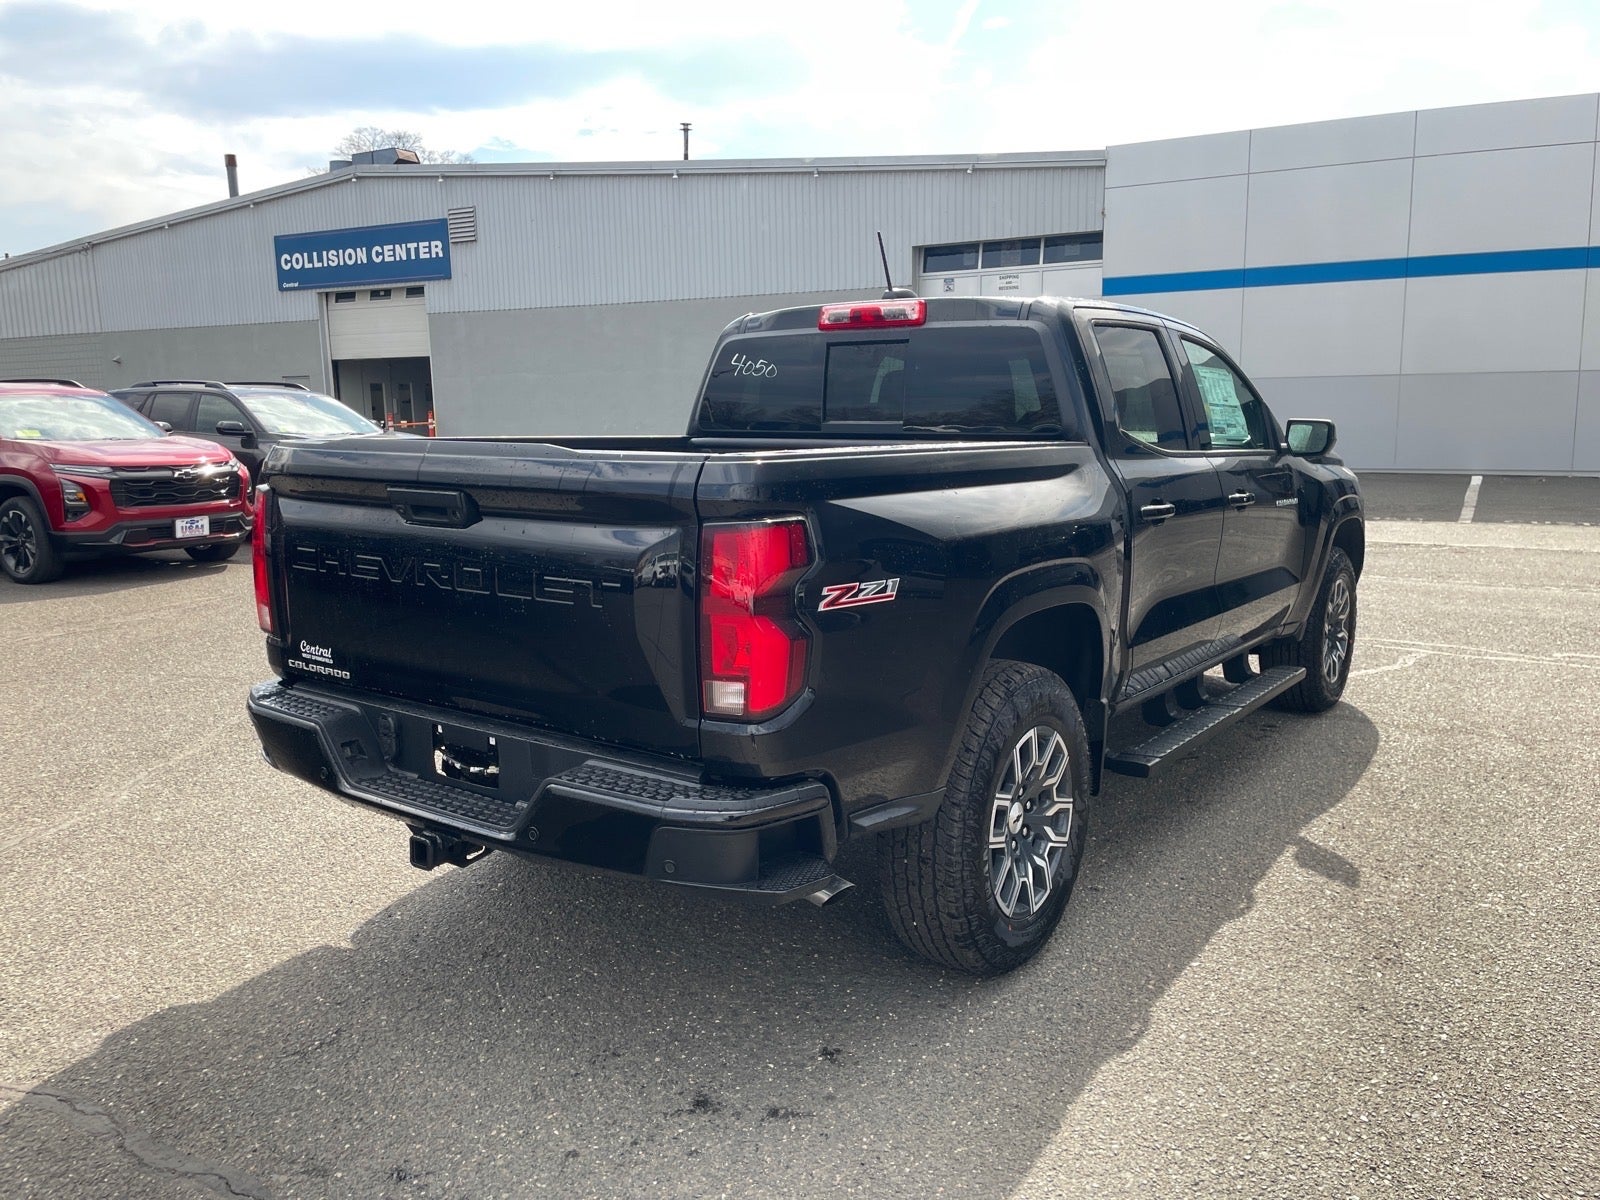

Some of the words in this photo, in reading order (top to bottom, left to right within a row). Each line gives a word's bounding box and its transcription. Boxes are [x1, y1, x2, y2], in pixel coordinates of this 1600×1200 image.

[280, 247, 367, 271] COLLISION
[371, 240, 443, 263] CENTER
[282, 281, 299, 289] Central
[731, 353, 777, 378] 4050
[292, 546, 622, 608] CHEVROLET
[818, 578, 900, 612] Z71
[300, 640, 332, 658] Central
[288, 659, 350, 679] COLORADO
